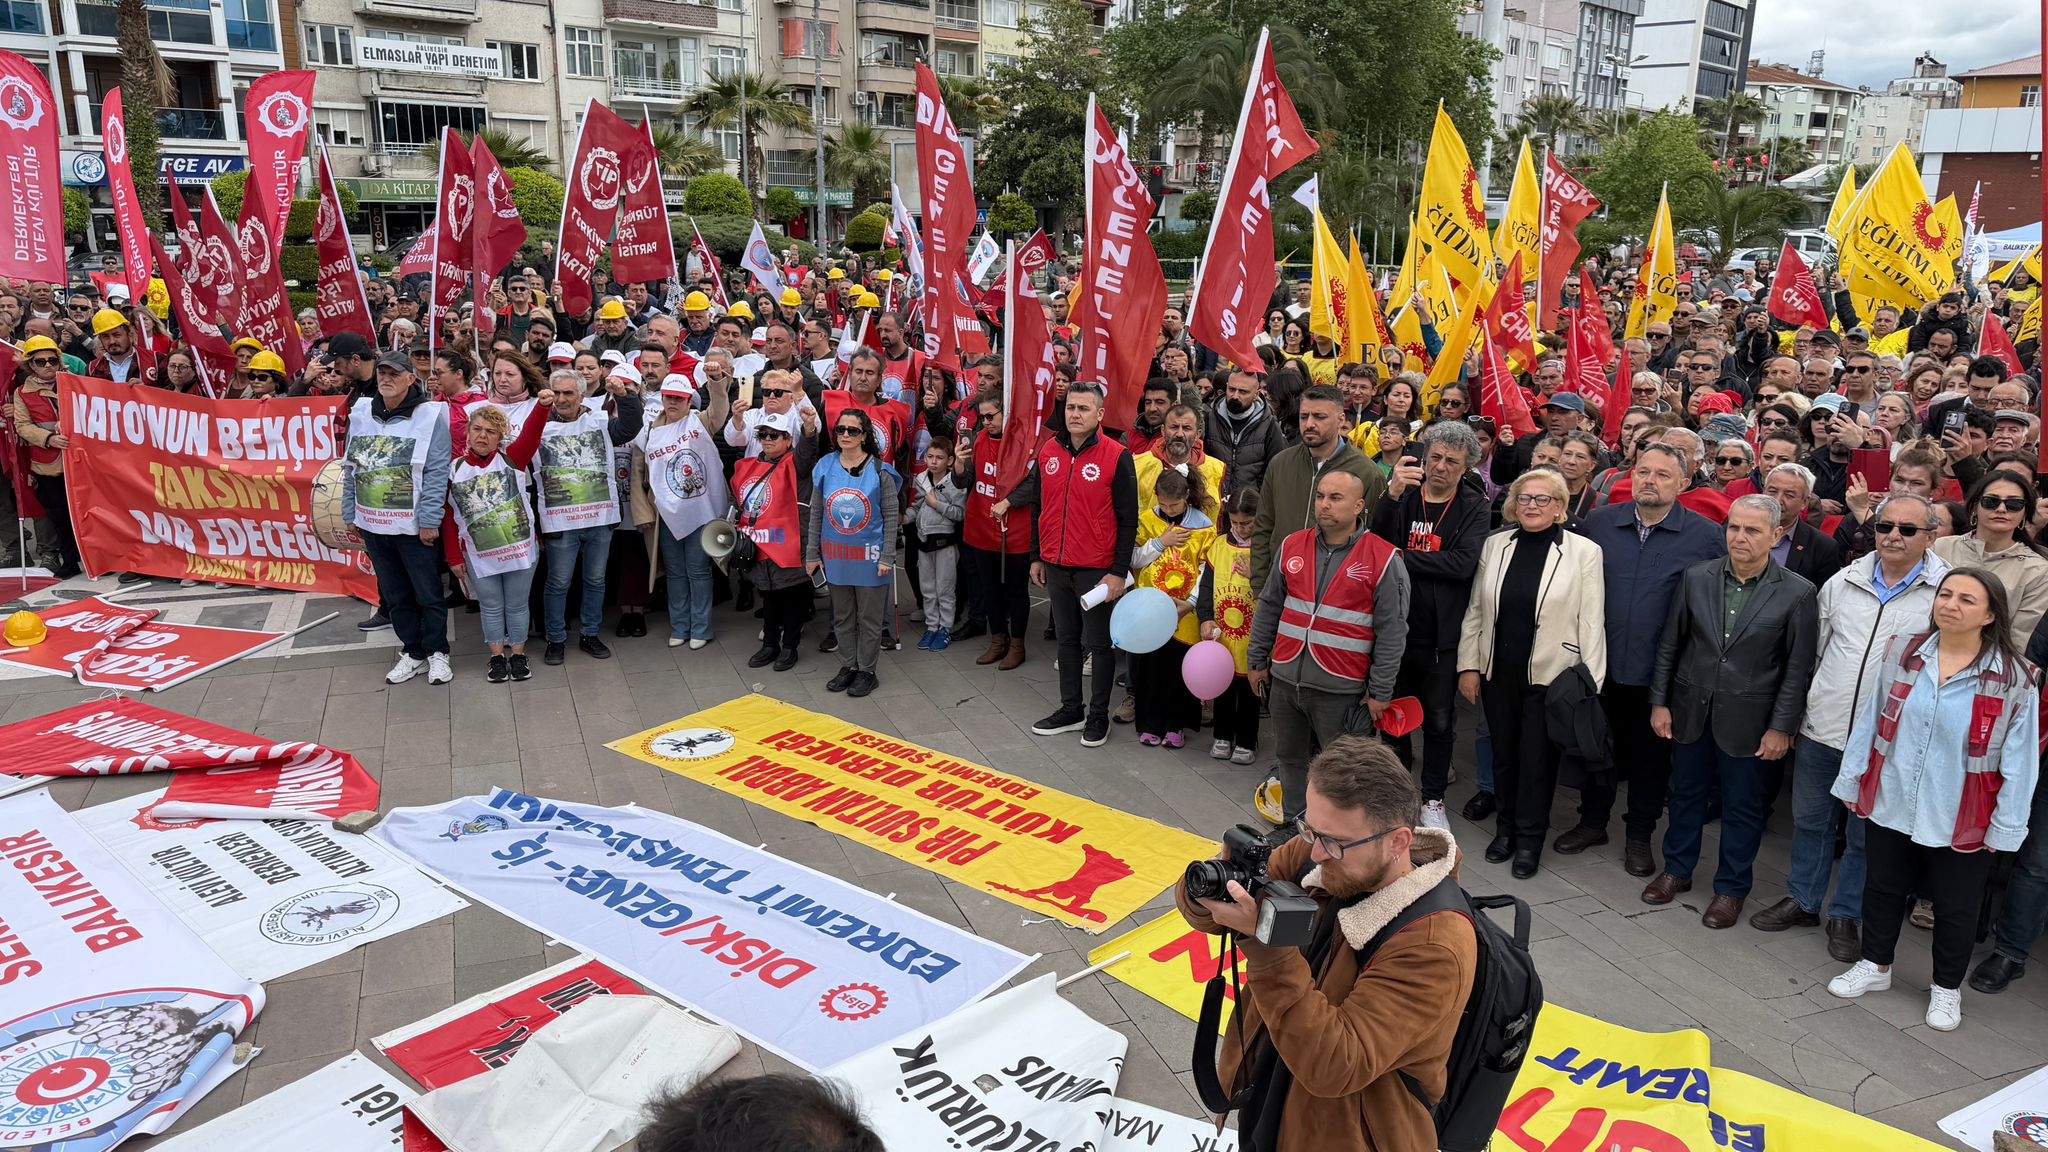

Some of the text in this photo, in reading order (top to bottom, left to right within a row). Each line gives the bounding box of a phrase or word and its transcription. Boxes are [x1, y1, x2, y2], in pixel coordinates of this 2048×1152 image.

[363, 46, 498, 70] ELMASLAR YAPI DENETİM
[203, 159, 232, 173] AV
[274, 149, 290, 208] KÜLTÜR
[393, 180, 430, 195] KİTAP
[595, 160, 619, 185] TİP
[829, 192, 853, 200] MARKET
[571, 206, 608, 255] TÜRKİYE
[1859, 216, 1931, 275] EĞİTİM
[1928, 275, 1949, 297] SE
[1782, 287, 1812, 313] CHP
[1500, 311, 1534, 344] CHP
[72, 391, 209, 457] NATO'NUN
[649, 429, 700, 461] BELEDYE-İŞ
[149, 461, 302, 513] TAKSİM'İ
[128, 508, 197, 555] DAR
[185, 555, 318, 587] YAŞASIN 1 MAYIS
[756, 729, 1083, 845] KÜLTÜR DERNEĞİ
[840, 731, 1042, 801] EDREMİT ŞUBESİ
[714, 755, 1002, 867] PİR SULTAN ABDAL
[150, 843, 248, 909] ALEVİ KÜLTÜR
[203, 831, 302, 886] DERNEKLERİ
[297, 829, 375, 879] ALTINOLUK
[0, 829, 144, 954] BALIKESİR
[323, 923, 367, 943] ALEVİ
[739, 883, 962, 984] EDREMİT
[835, 991, 872, 1012] DİSK
